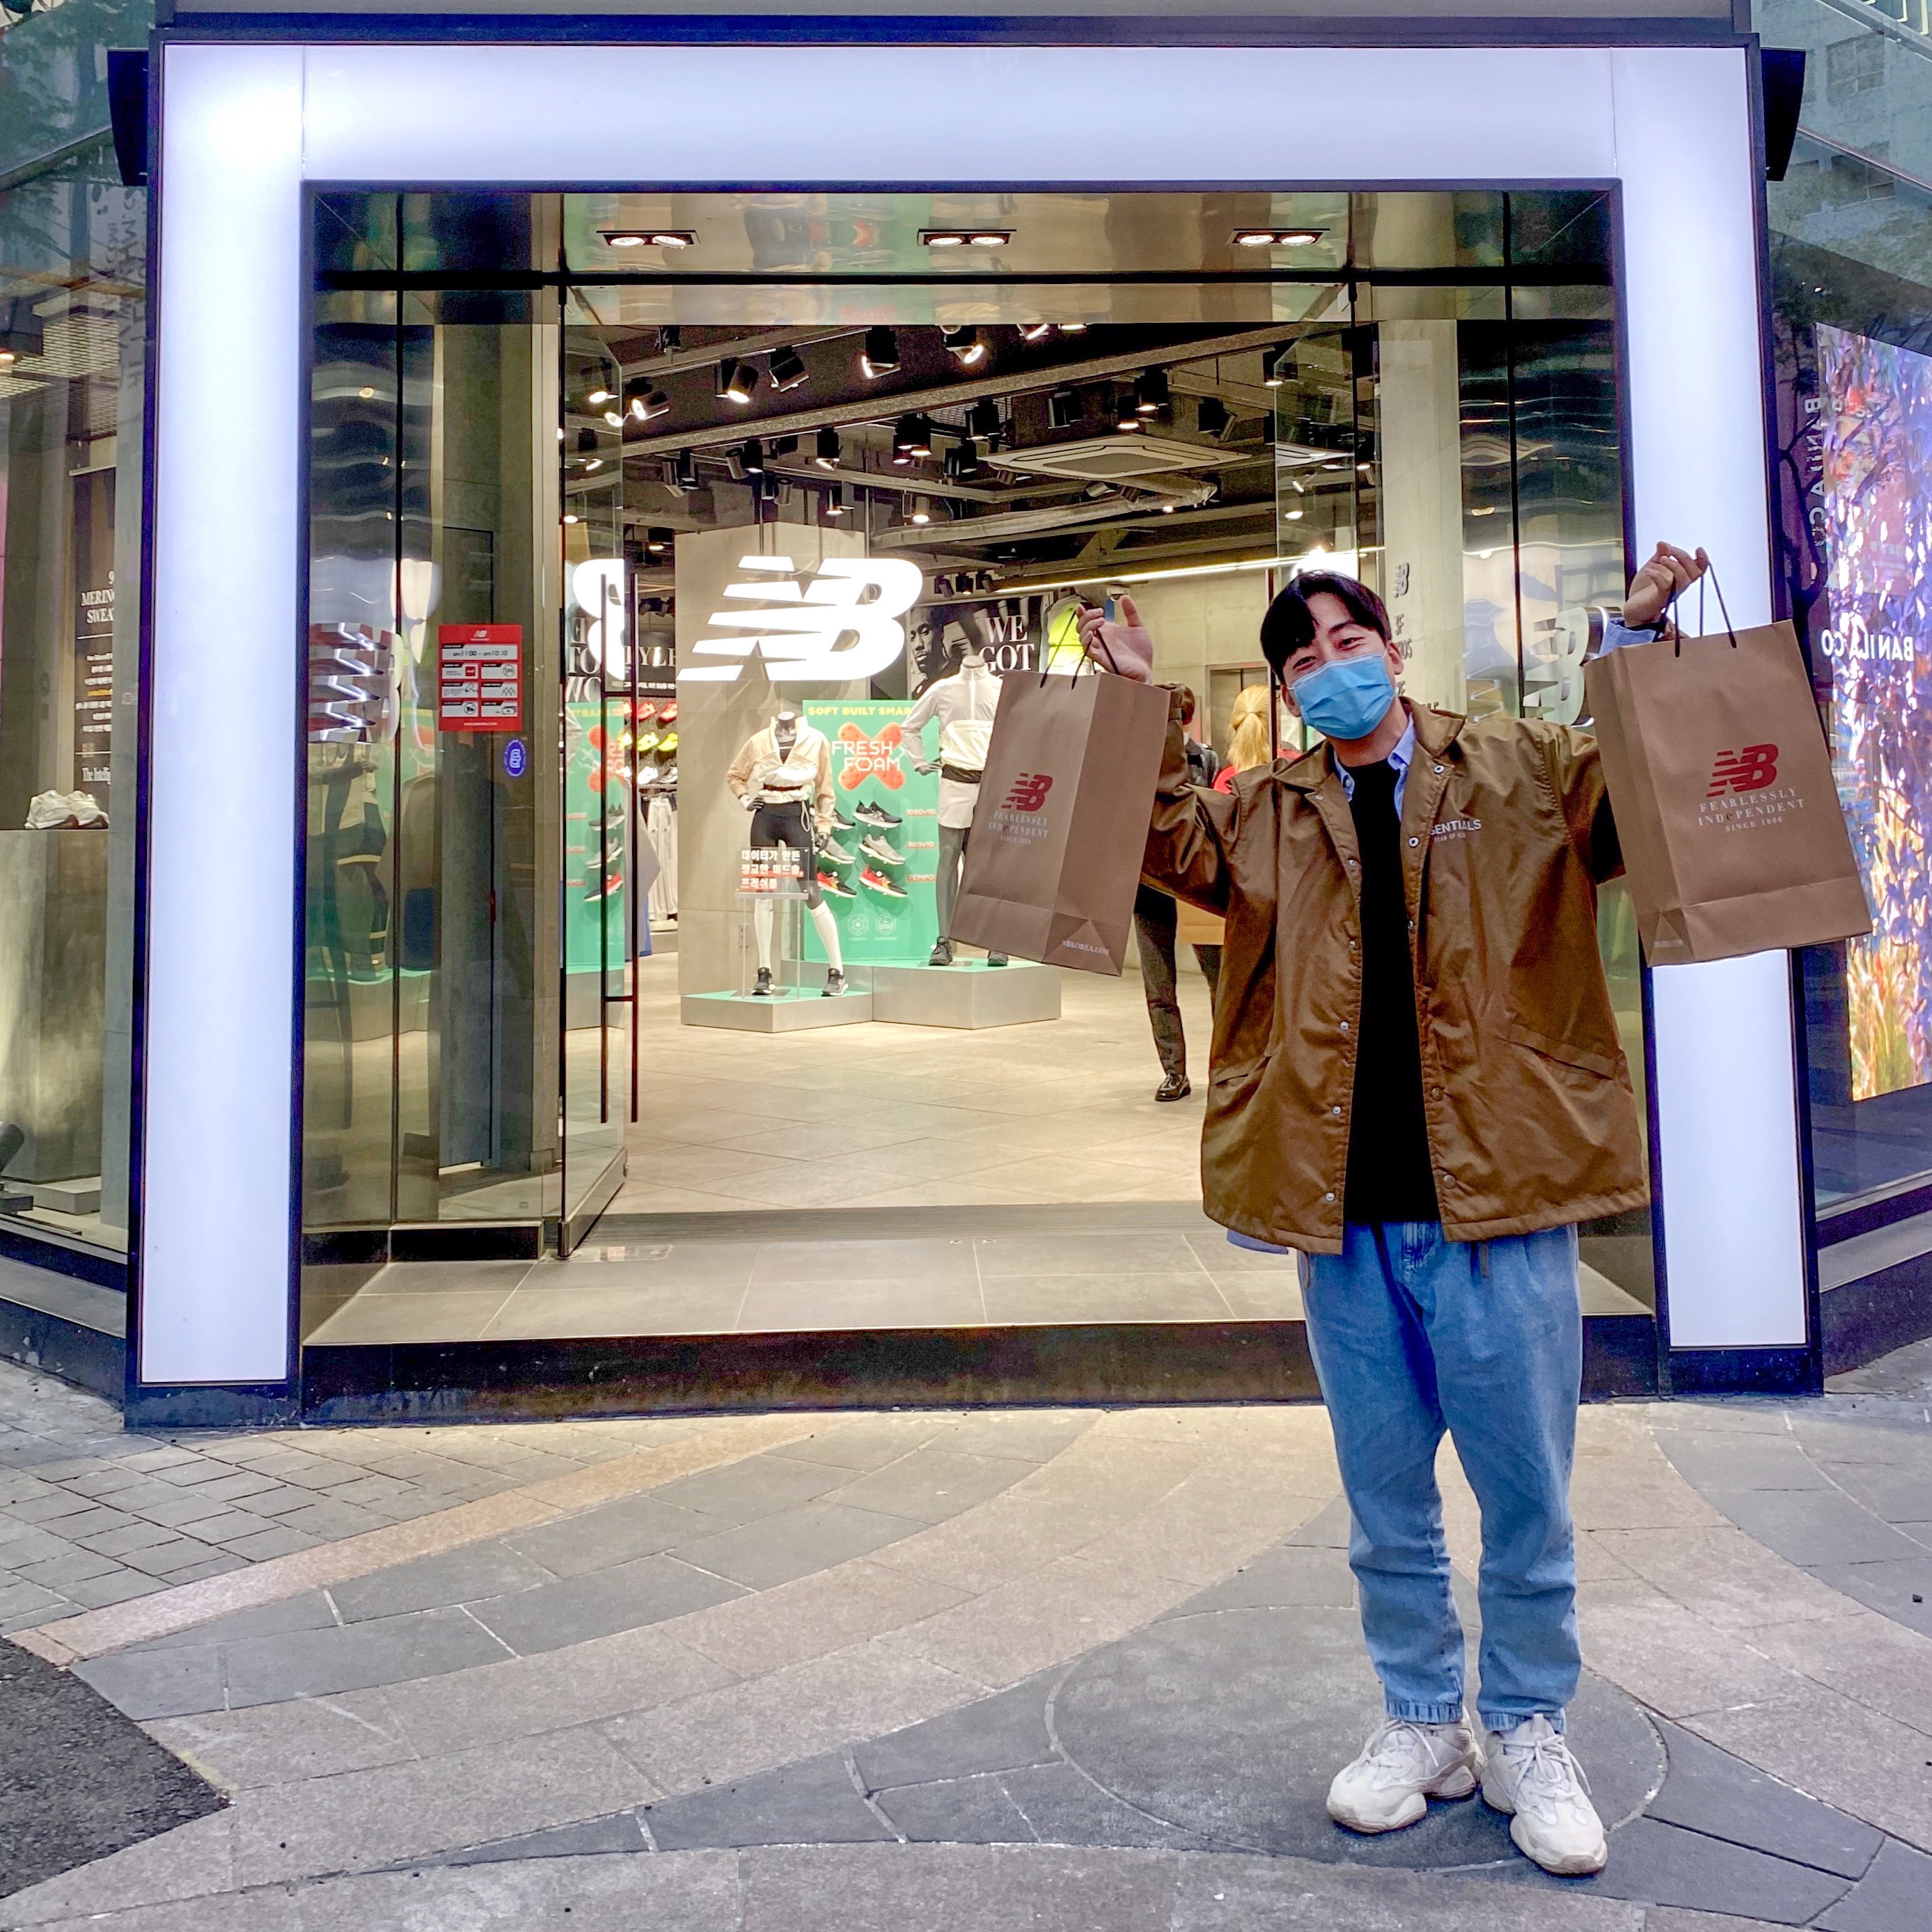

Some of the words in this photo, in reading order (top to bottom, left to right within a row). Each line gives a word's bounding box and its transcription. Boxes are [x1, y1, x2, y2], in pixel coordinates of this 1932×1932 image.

[81, 588, 115, 606] MERIN
[86, 607, 114, 624] SWEA
[984, 615, 1028, 643] WE
[978, 643, 1036, 672] GOT
[808, 707, 840, 716] SOFT
[842, 707, 876, 716] BUILT
[878, 707, 911, 716] SMAR
[832, 741, 893, 755] FRESH
[844, 757, 901, 772] FOAM
[1706, 744, 1779, 797] NB
[1000, 773, 1053, 812] NB
[1699, 788, 1796, 813] FEARLESSLY
[1725, 821, 1757, 832] SINCE
[741, 850, 778, 861] 데이터가
[782, 851, 801, 861] 만든
